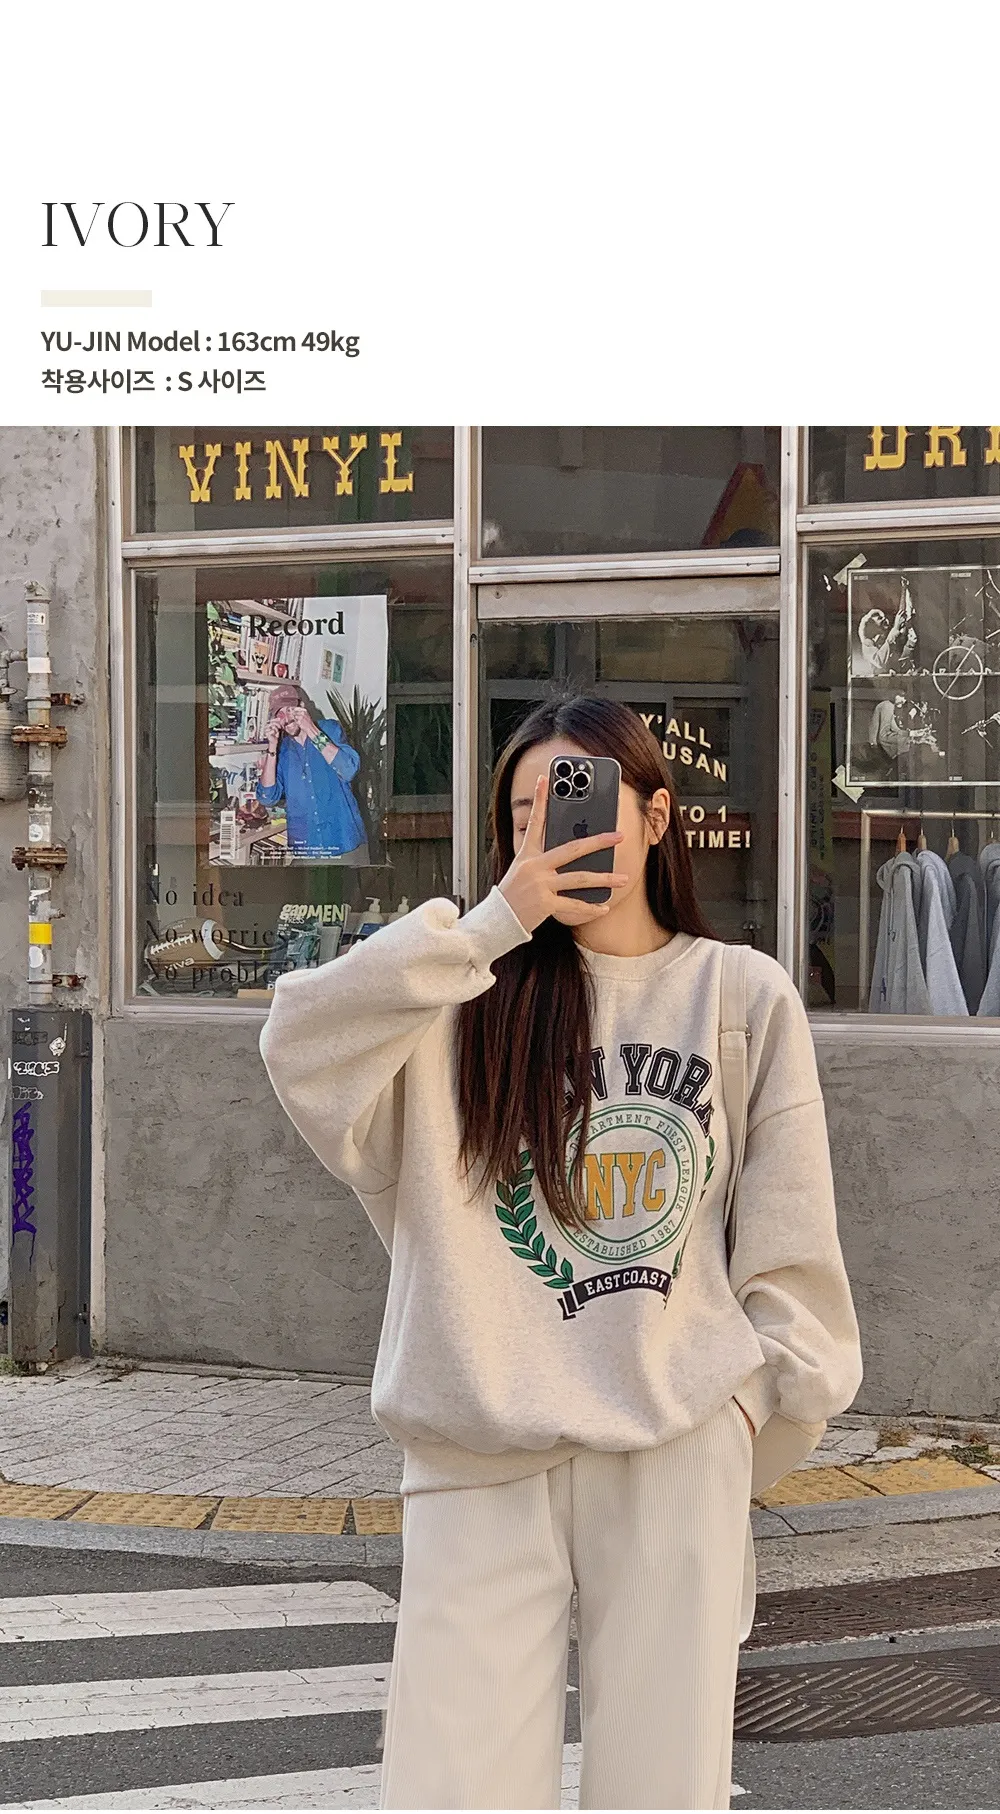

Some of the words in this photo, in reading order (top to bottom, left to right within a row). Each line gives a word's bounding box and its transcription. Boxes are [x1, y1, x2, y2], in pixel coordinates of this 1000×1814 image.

[178, 432, 414, 504] VINYL
[248, 611, 345, 639] Record
[639, 713, 711, 748] Y'ALL
[717, 805, 727, 823] 1
[685, 830, 751, 848] TIME!
[146, 882, 178, 906] No
[192, 882, 245, 907] idea
[192, 960, 289, 989] proble
[569, 1113, 652, 1152] DARTMENT
[675, 1159, 690, 1212] LEAGUE
[584, 1148, 666, 1220] NYC
[572, 1227, 648, 1257] ESTABLISHED
[651, 1219, 676, 1243] 1987
[584, 1274, 621, 1296] EAST
[623, 1270, 668, 1289] COAST
